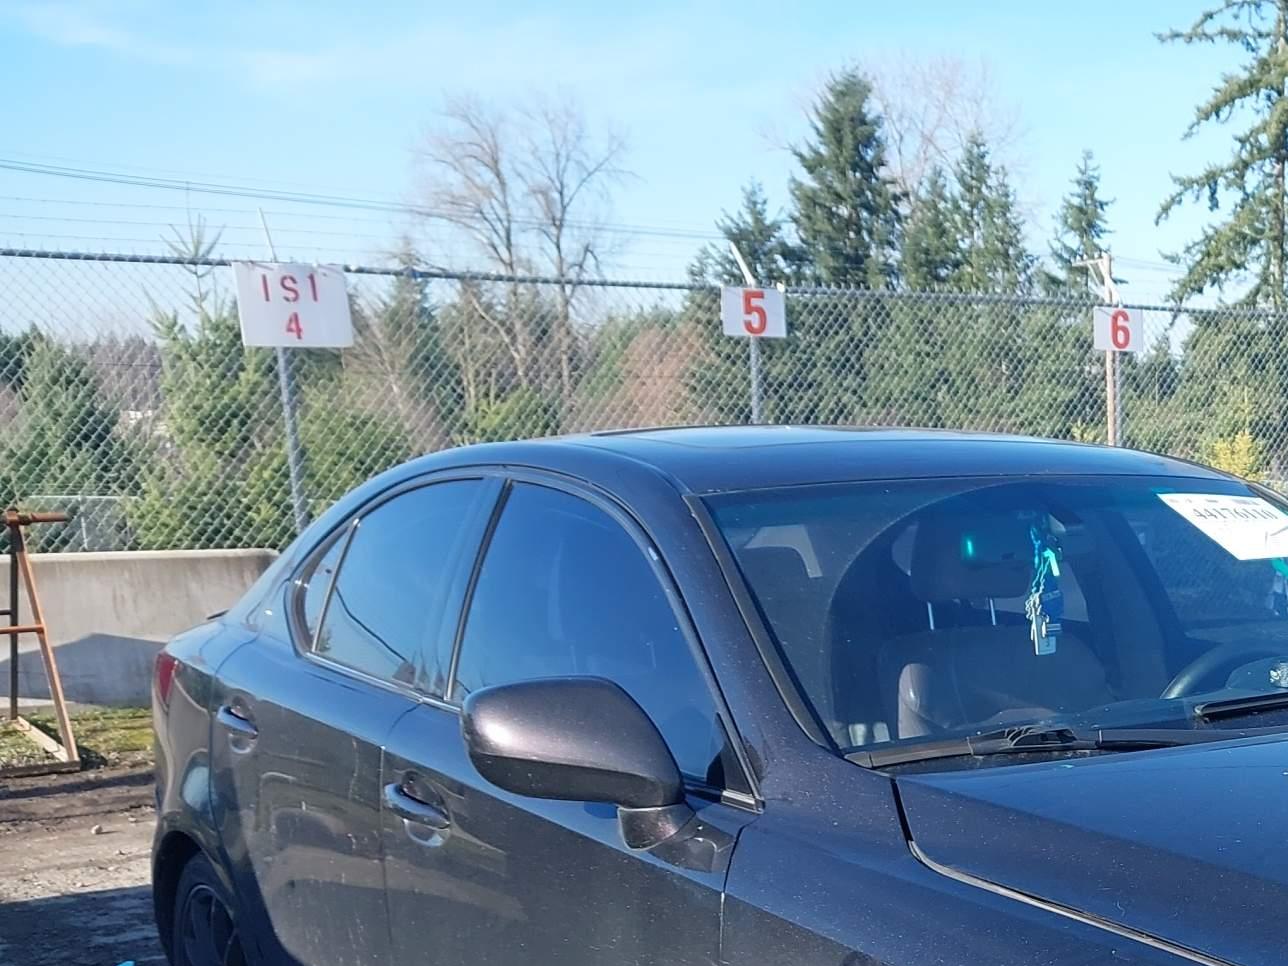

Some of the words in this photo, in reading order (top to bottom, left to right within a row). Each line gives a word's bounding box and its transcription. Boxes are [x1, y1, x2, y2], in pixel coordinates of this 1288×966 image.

[286, 311, 303, 340] 4
[743, 290, 767, 335] 5
[1111, 309, 1130, 350] 6
